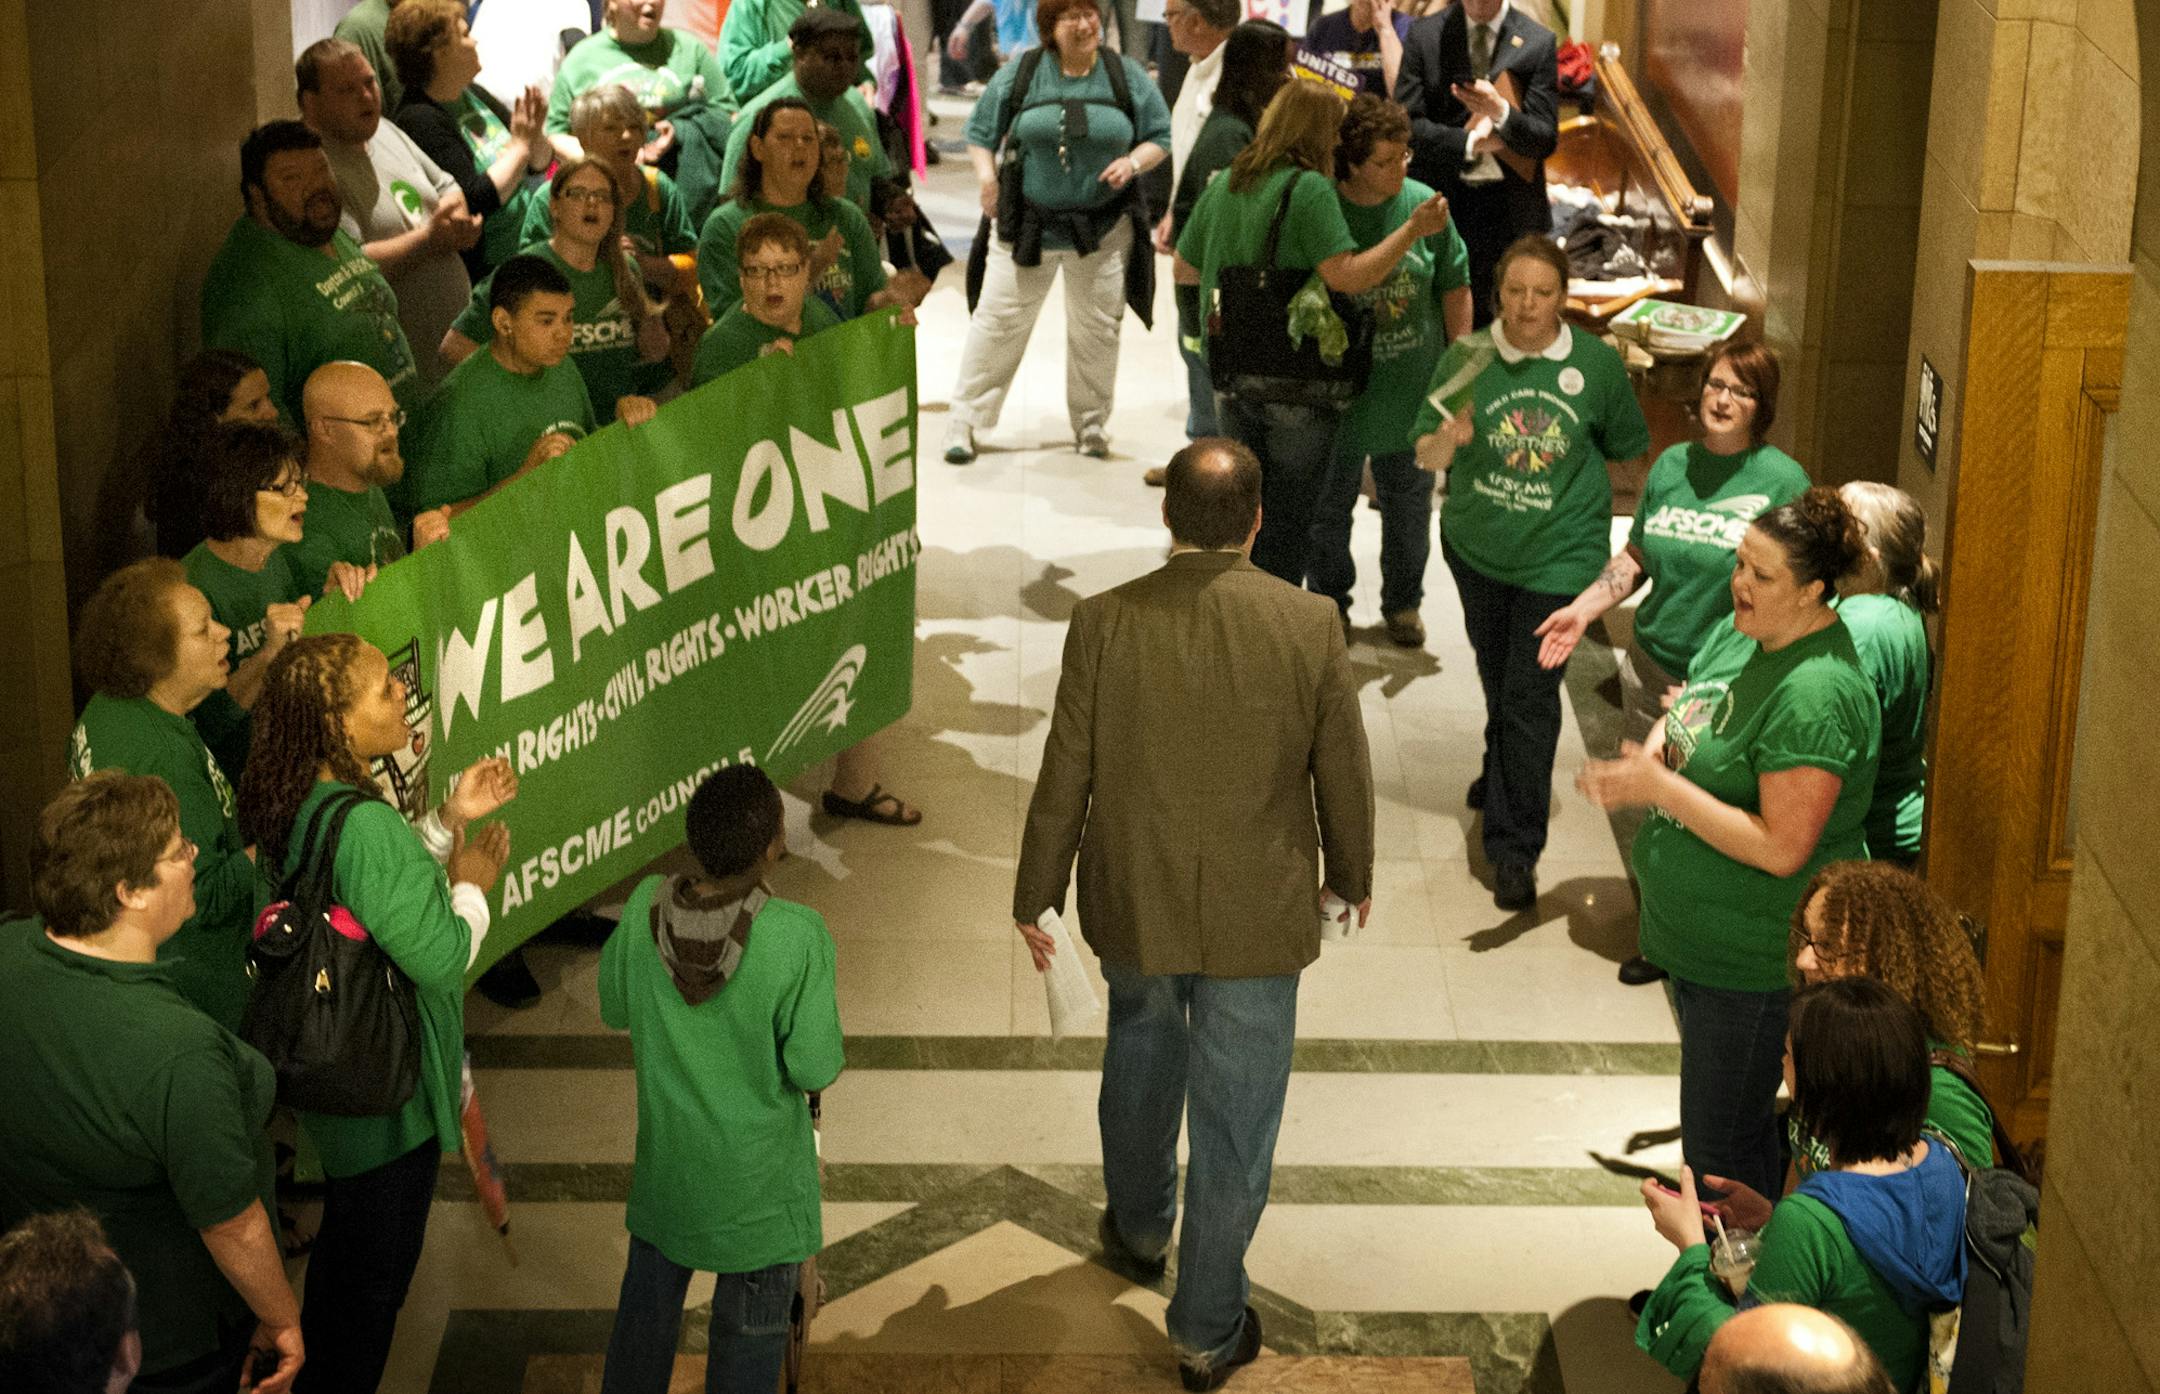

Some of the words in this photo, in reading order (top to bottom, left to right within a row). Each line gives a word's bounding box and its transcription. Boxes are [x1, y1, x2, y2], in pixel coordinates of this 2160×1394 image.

[1296, 48, 1359, 89] UNITED
[571, 319, 636, 345] FSCM
[439, 572, 555, 742] WE
[566, 472, 716, 662] ARE
[731, 386, 915, 552] ONE
[517, 698, 598, 776] RIGHTS
[604, 658, 645, 721] CIVIL
[645, 612, 726, 692] RIGHTS
[734, 563, 854, 642] WORKER
[856, 524, 920, 592] RIGHTS
[501, 805, 633, 918] AFSCME
